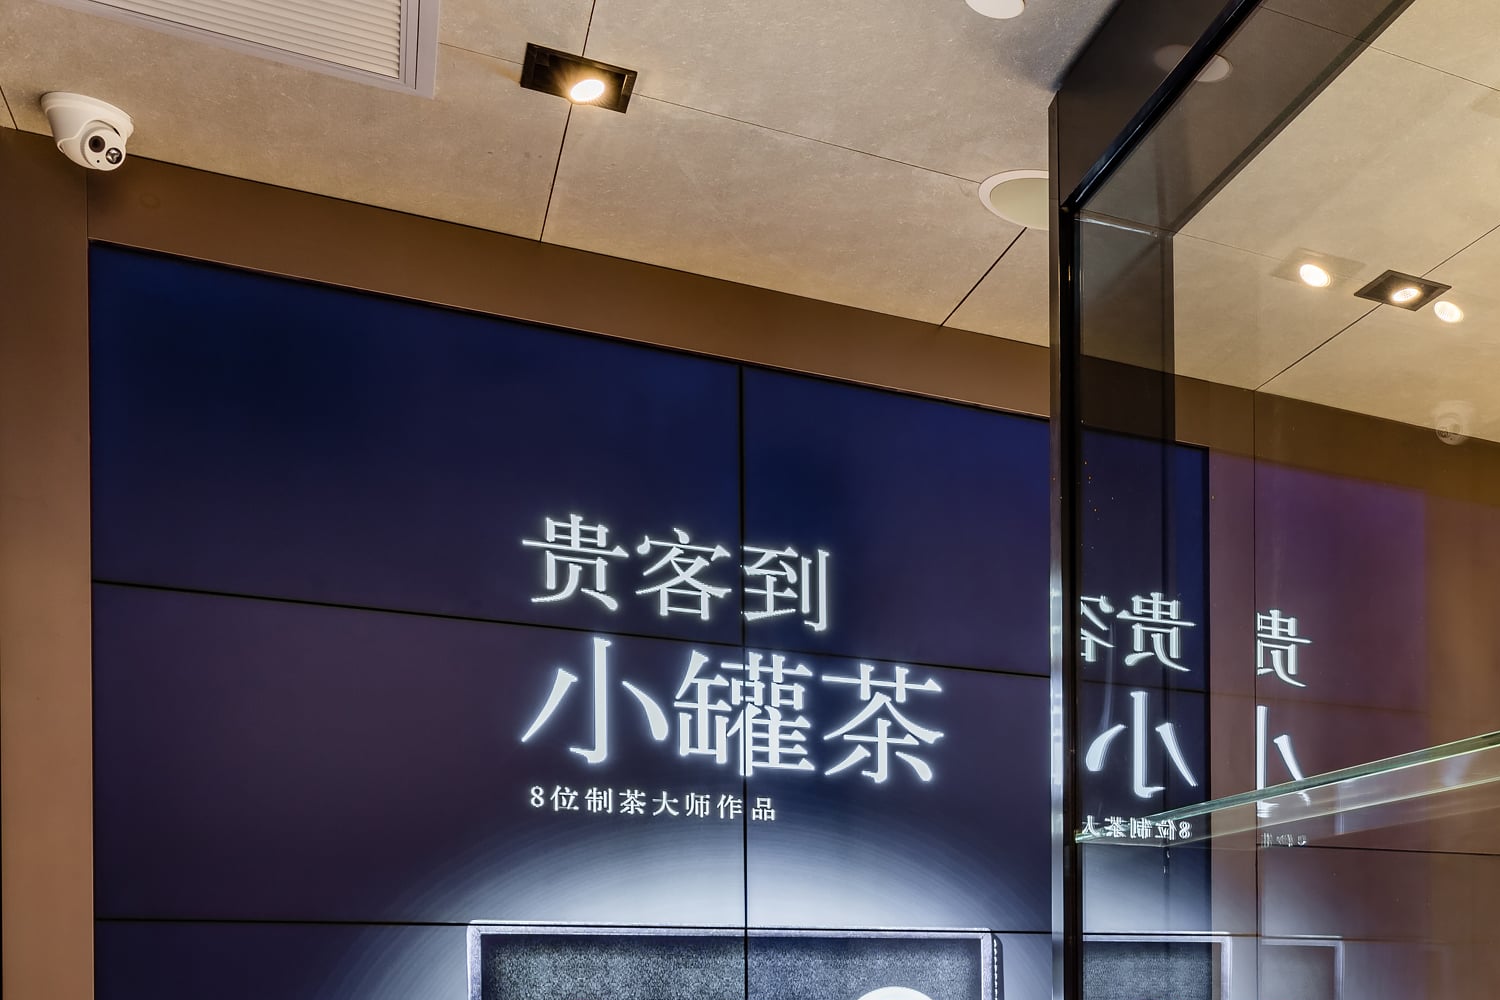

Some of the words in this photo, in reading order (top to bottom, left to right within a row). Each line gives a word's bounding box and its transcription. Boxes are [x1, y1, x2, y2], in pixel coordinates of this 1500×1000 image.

[521, 513, 830, 631] 贵客到
[521, 637, 944, 783] 小罐茶
[530, 785, 776, 821] 8位制茶大师作品
